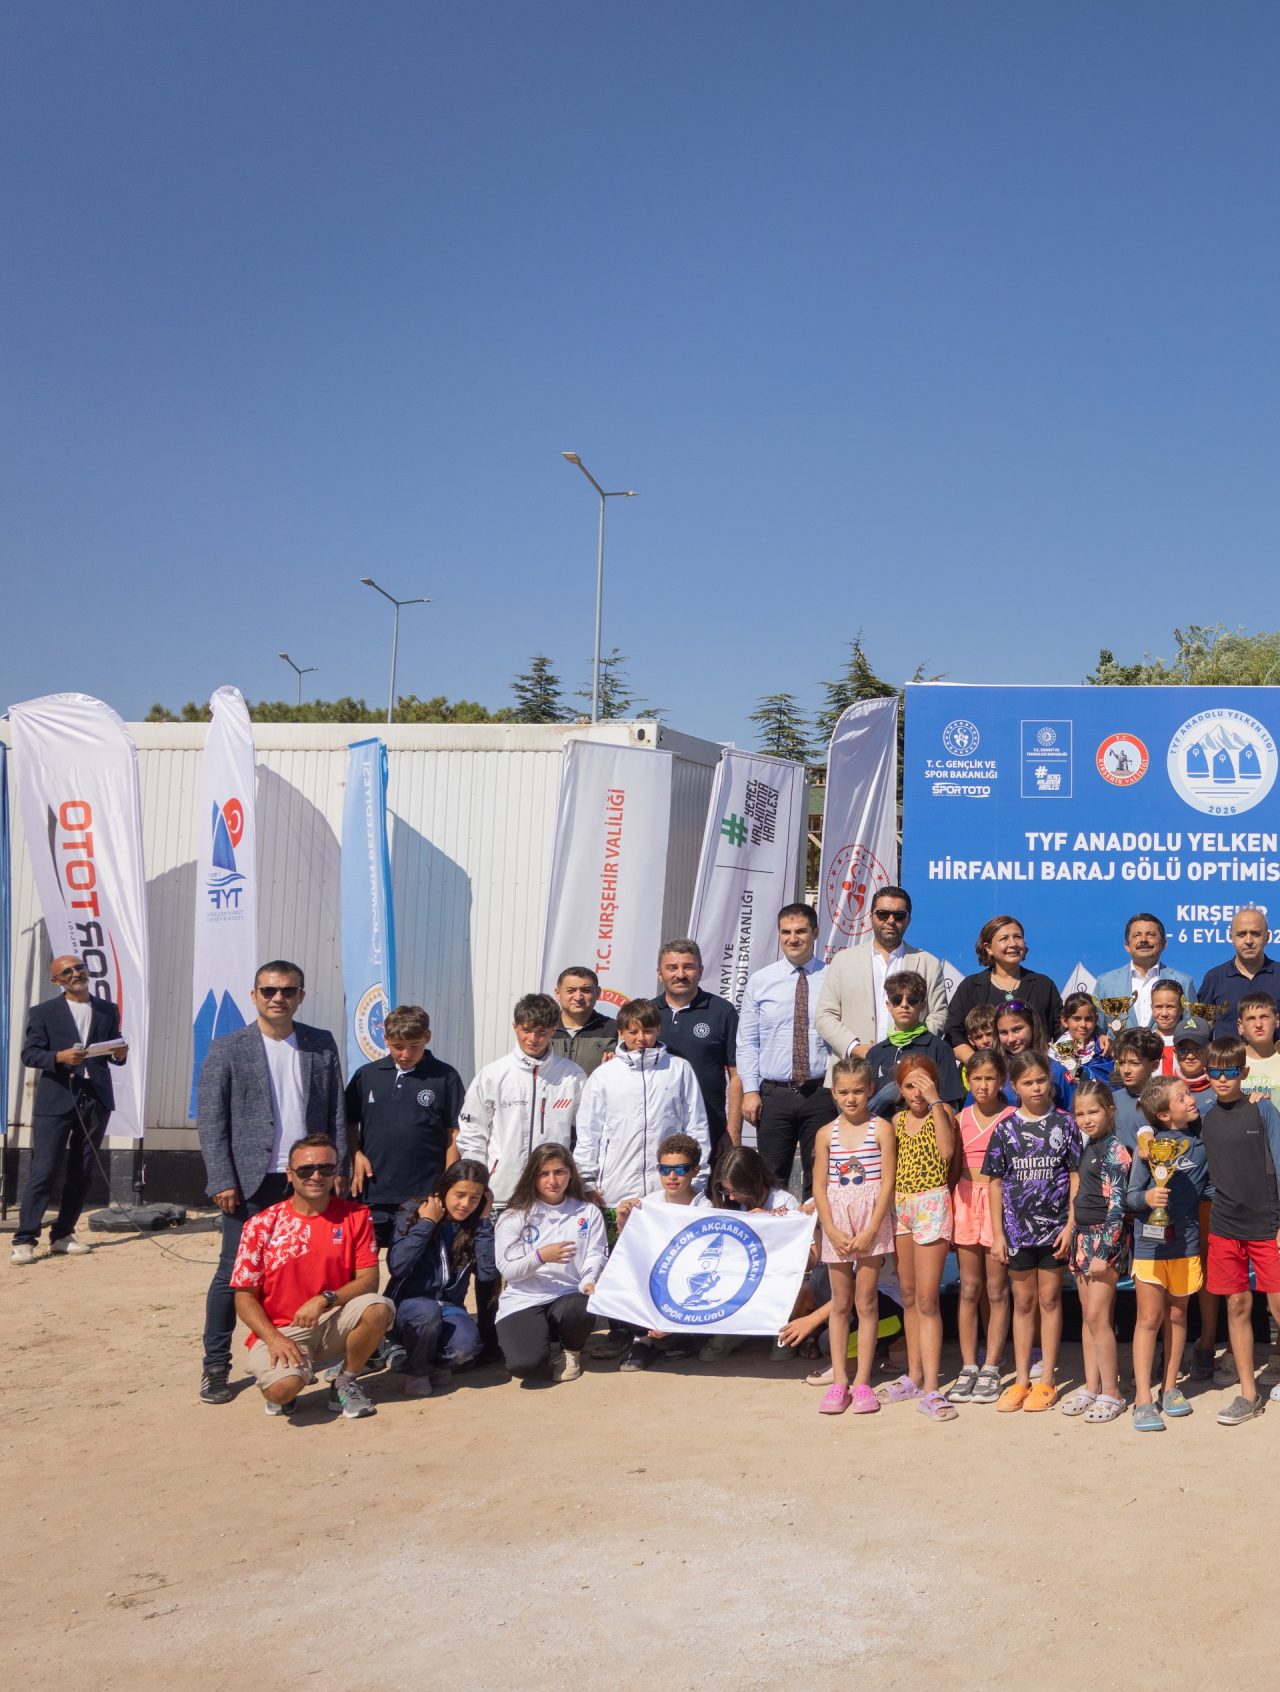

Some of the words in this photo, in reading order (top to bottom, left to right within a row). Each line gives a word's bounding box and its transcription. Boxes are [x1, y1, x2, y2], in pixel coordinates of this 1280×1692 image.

[1180, 710, 1223, 736] ANADOLU
[1228, 711, 1262, 733] YELKEN
[924, 770, 949, 779] SPOR
[950, 769, 998, 779] BAKANLIĞI
[945, 758, 983, 770] GENÇLİK
[984, 760, 996, 769] VE
[744, 779, 758, 818] YEREL
[1208, 805, 1237, 815] 2026
[604, 788, 625, 859] VALİLİĞİ
[750, 782, 769, 846] KALKINMA
[762, 787, 779, 843] HAMLESİ
[1025, 832, 1068, 851] TYF
[1072, 832, 1182, 852] ANADOLU
[1187, 832, 1278, 852] YELKEN
[928, 855, 1034, 880] HİRFANLI
[1040, 861, 1115, 881] BARAJ
[1121, 856, 1181, 881] GÖLÜ
[598, 862, 619, 940] KIRŞEHİR
[1176, 900, 1268, 926] KIRŞE
[738, 889, 754, 962] BAKANLIĞI
[1178, 928, 1188, 943] 6
[1193, 926, 1233, 943] EYLÜ
[595, 943, 611, 974] T.C.
[723, 943, 734, 961] VE
[1011, 1155, 1062, 1170] Emirates
[658, 1231, 694, 1275] TRABZON
[701, 1222, 750, 1241] AKÇAABAT
[747, 1241, 761, 1282] YELKEN
[661, 1303, 684, 1320] SPOR
[683, 1309, 725, 1323] KULÜBÜ
